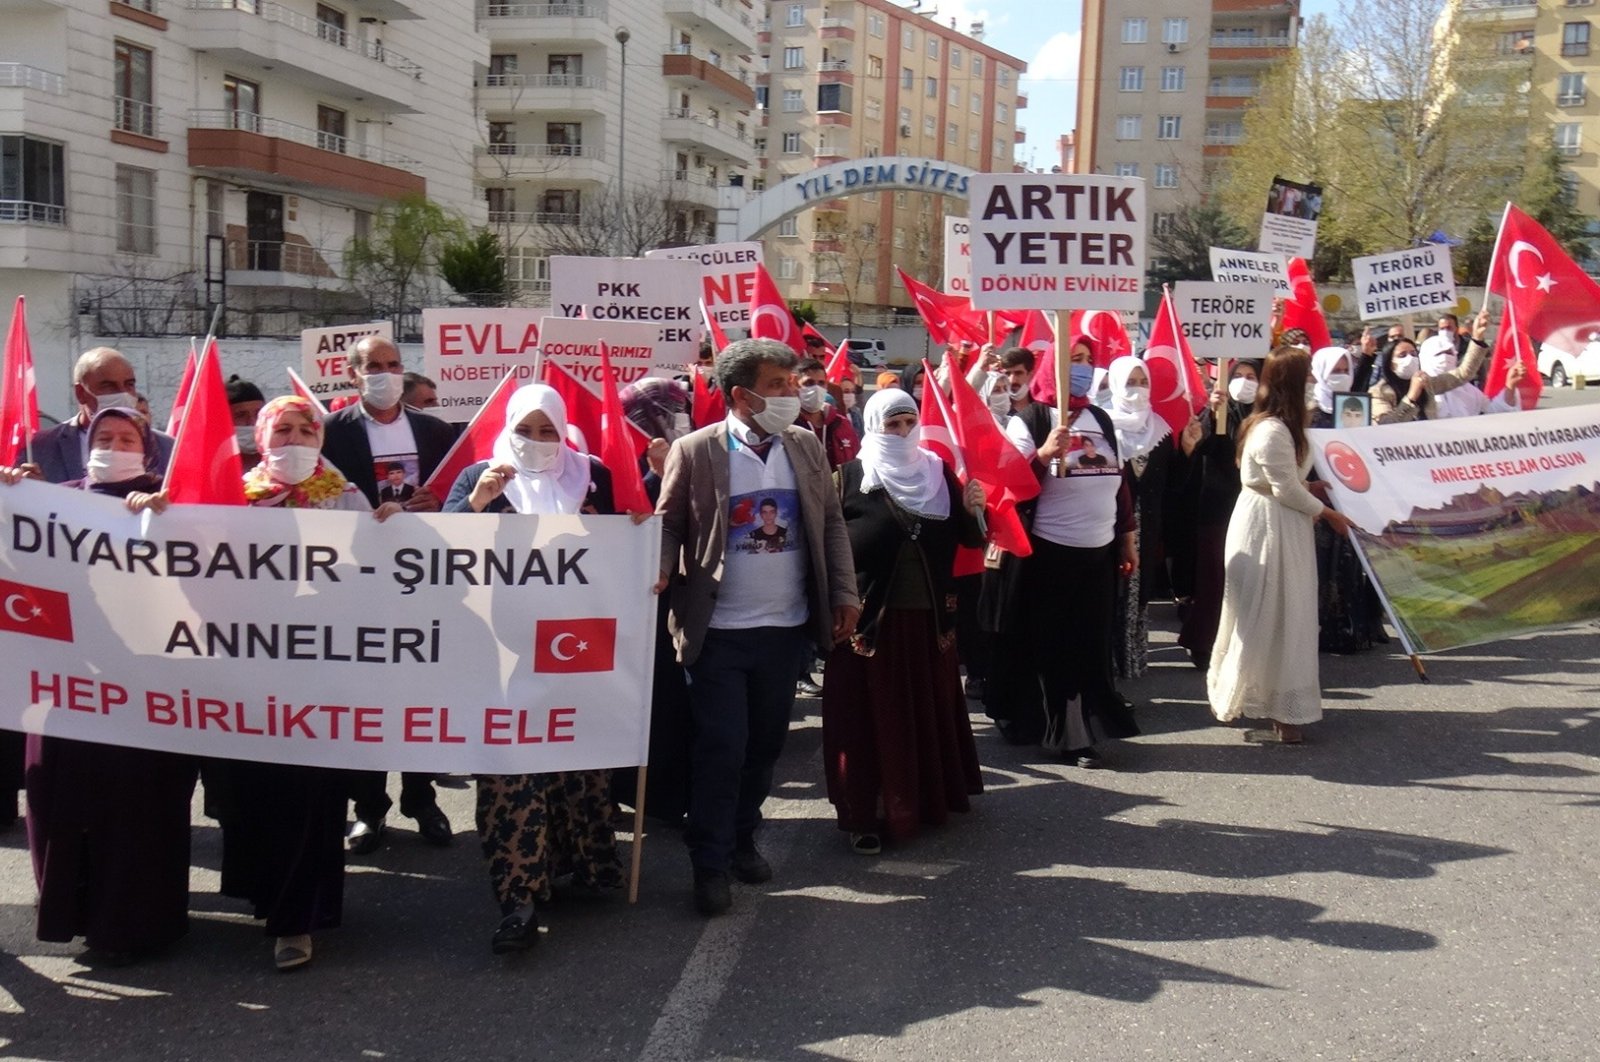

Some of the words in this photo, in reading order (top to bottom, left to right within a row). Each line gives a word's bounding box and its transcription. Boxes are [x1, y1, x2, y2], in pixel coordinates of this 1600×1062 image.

[905, 161, 970, 194] SİTES
[982, 184, 1137, 222] ARTIK
[984, 232, 1135, 266] YETER
[1370, 250, 1435, 275] TERÖRÜ
[1219, 258, 1280, 273] ANNELER
[598, 282, 640, 297] PKK
[981, 273, 1057, 292] DÖNÜN
[1064, 272, 1138, 293] EVİNİZE
[1367, 272, 1444, 295] ANNELER
[1191, 295, 1255, 314] TERÖRE
[1365, 290, 1452, 313] BİTİRECEK
[440, 323, 538, 355] EVLA
[1182, 320, 1226, 340] GEÇİT
[1231, 323, 1263, 338] YOK
[441, 364, 534, 381] NÖBETİND
[1373, 443, 1436, 466] ŞIRNAKLI
[1435, 433, 1528, 457] KADINLARDAN
[1430, 463, 1497, 483] ANNELERE
[1496, 458, 1540, 476] SELAM
[1540, 451, 1587, 470] OLSUN
[12, 512, 341, 583] DİYARBAKIR
[393, 548, 590, 595] ŞIRNAK
[165, 619, 441, 664] ANNELERİ
[30, 670, 129, 714] HEP
[146, 689, 385, 743] BİRLİKTE
[404, 706, 466, 743] EL
[483, 707, 577, 745] ELE
